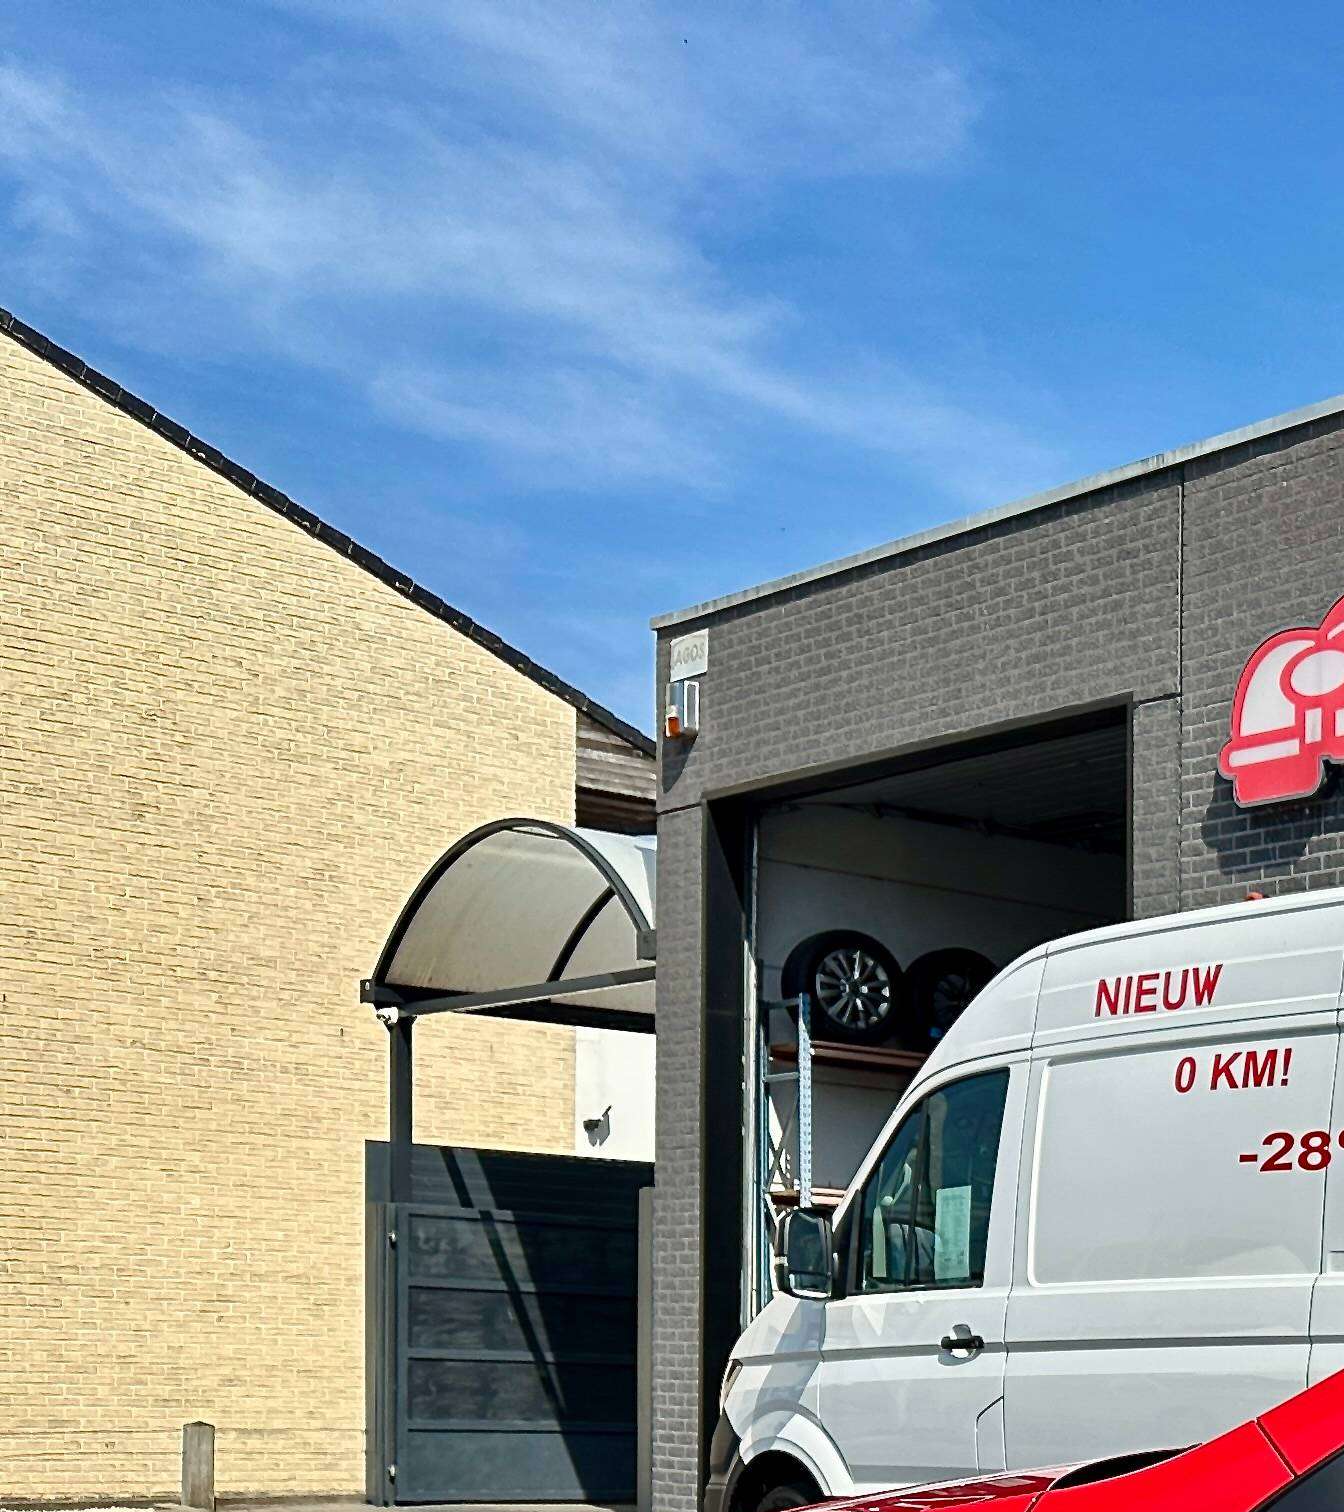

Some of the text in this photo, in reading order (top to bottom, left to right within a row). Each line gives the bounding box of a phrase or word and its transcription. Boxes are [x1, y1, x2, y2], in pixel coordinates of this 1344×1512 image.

[1094, 964, 1223, 1017] NIEUW
[1174, 1048, 1292, 1093] 0 KM!
